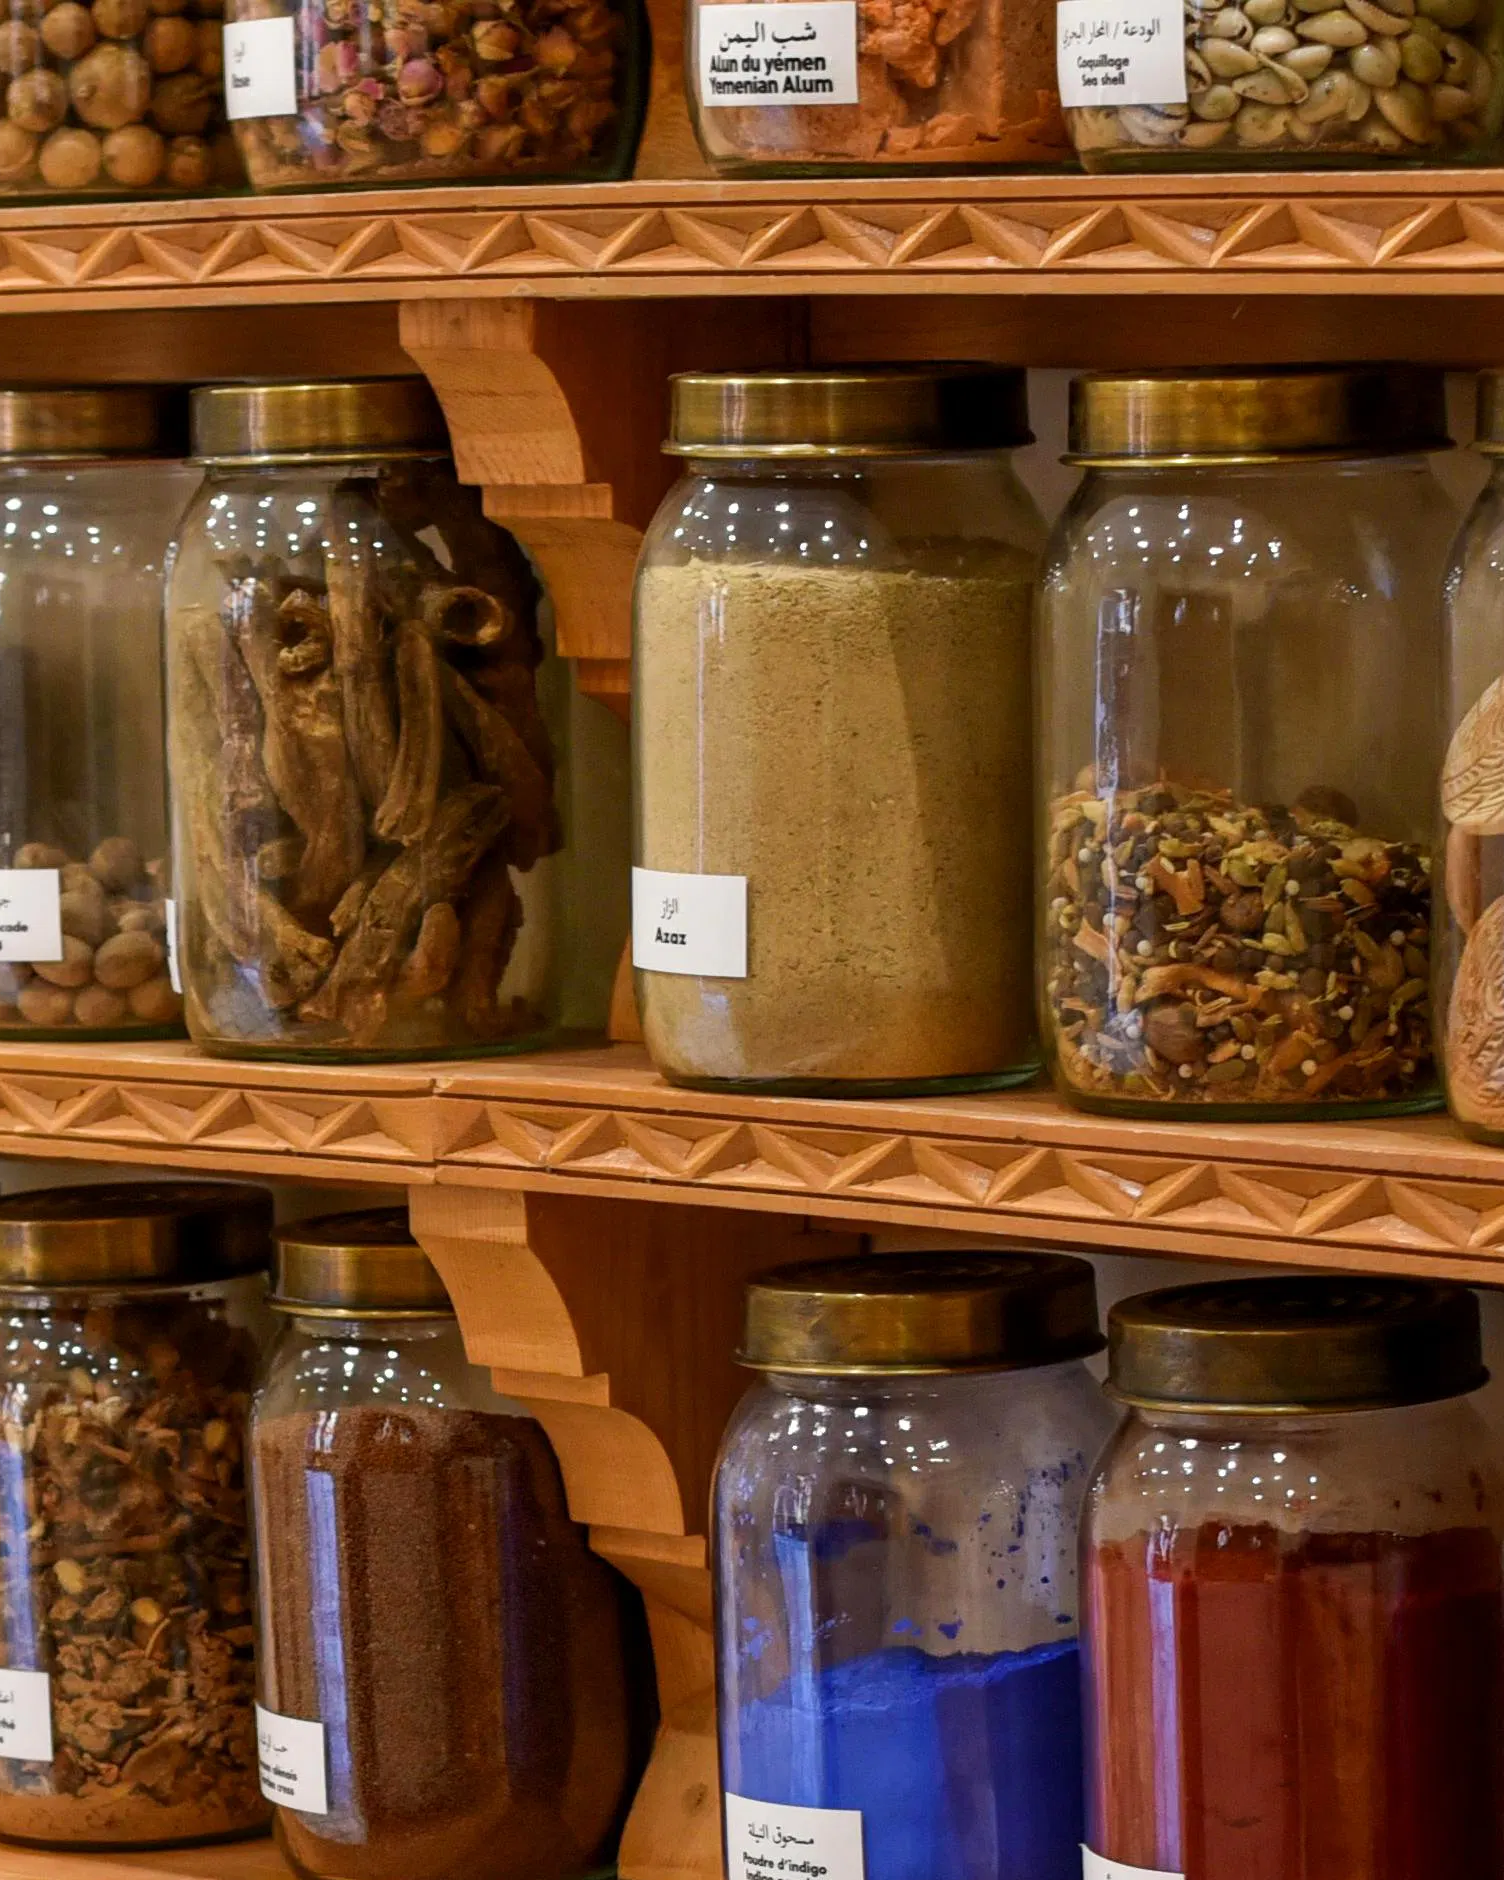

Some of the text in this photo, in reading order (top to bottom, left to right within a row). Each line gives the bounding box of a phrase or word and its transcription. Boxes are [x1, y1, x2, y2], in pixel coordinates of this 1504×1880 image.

[719, 21, 817, 52] شب اليمن
[709, 51, 826, 76] Alun du yémen
[1077, 54, 1129, 71] Coquillage
[709, 75, 834, 95] Yemenian Alum
[1082, 74, 1098, 87] Sea
[655, 927, 687, 946] Azaz
[743, 1851, 774, 1869] Poudre
